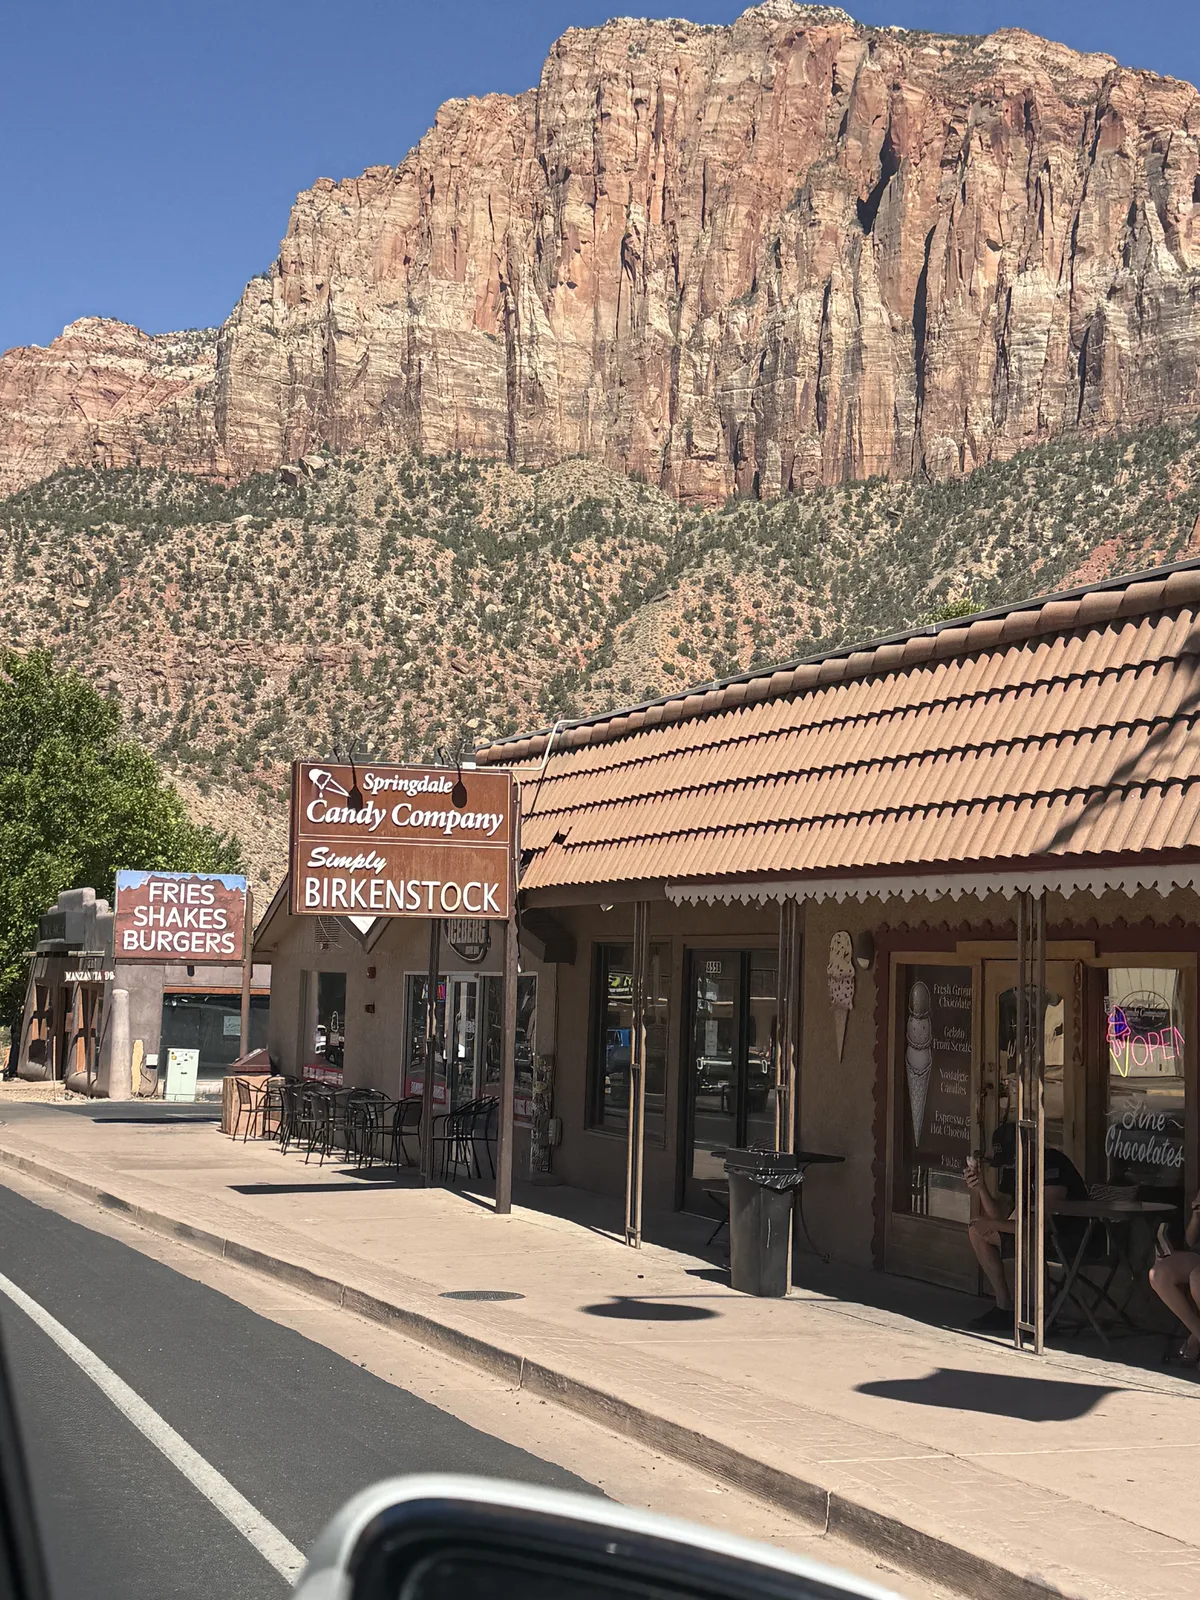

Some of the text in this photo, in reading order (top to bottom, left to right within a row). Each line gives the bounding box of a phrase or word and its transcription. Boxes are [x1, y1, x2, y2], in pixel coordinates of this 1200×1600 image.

[363, 773, 453, 797] Springdale
[306, 799, 504, 836] Candy Company
[307, 846, 387, 875] Simply
[149, 882, 215, 905] FRIES
[304, 877, 500, 912] BIRKENSTOCK
[133, 905, 227, 930] SHAKES
[123, 929, 235, 954] BURGERS
[933, 983, 951, 995] Fresh
[933, 1038, 972, 1053] From Scratc
[1131, 1027, 1184, 1066] OPEN
[935, 1110, 964, 1126] Espresso
[1121, 1100, 1166, 1132] Fine
[930, 1122, 943, 1136] Hot
[1105, 1124, 1185, 1168] Chocolates
